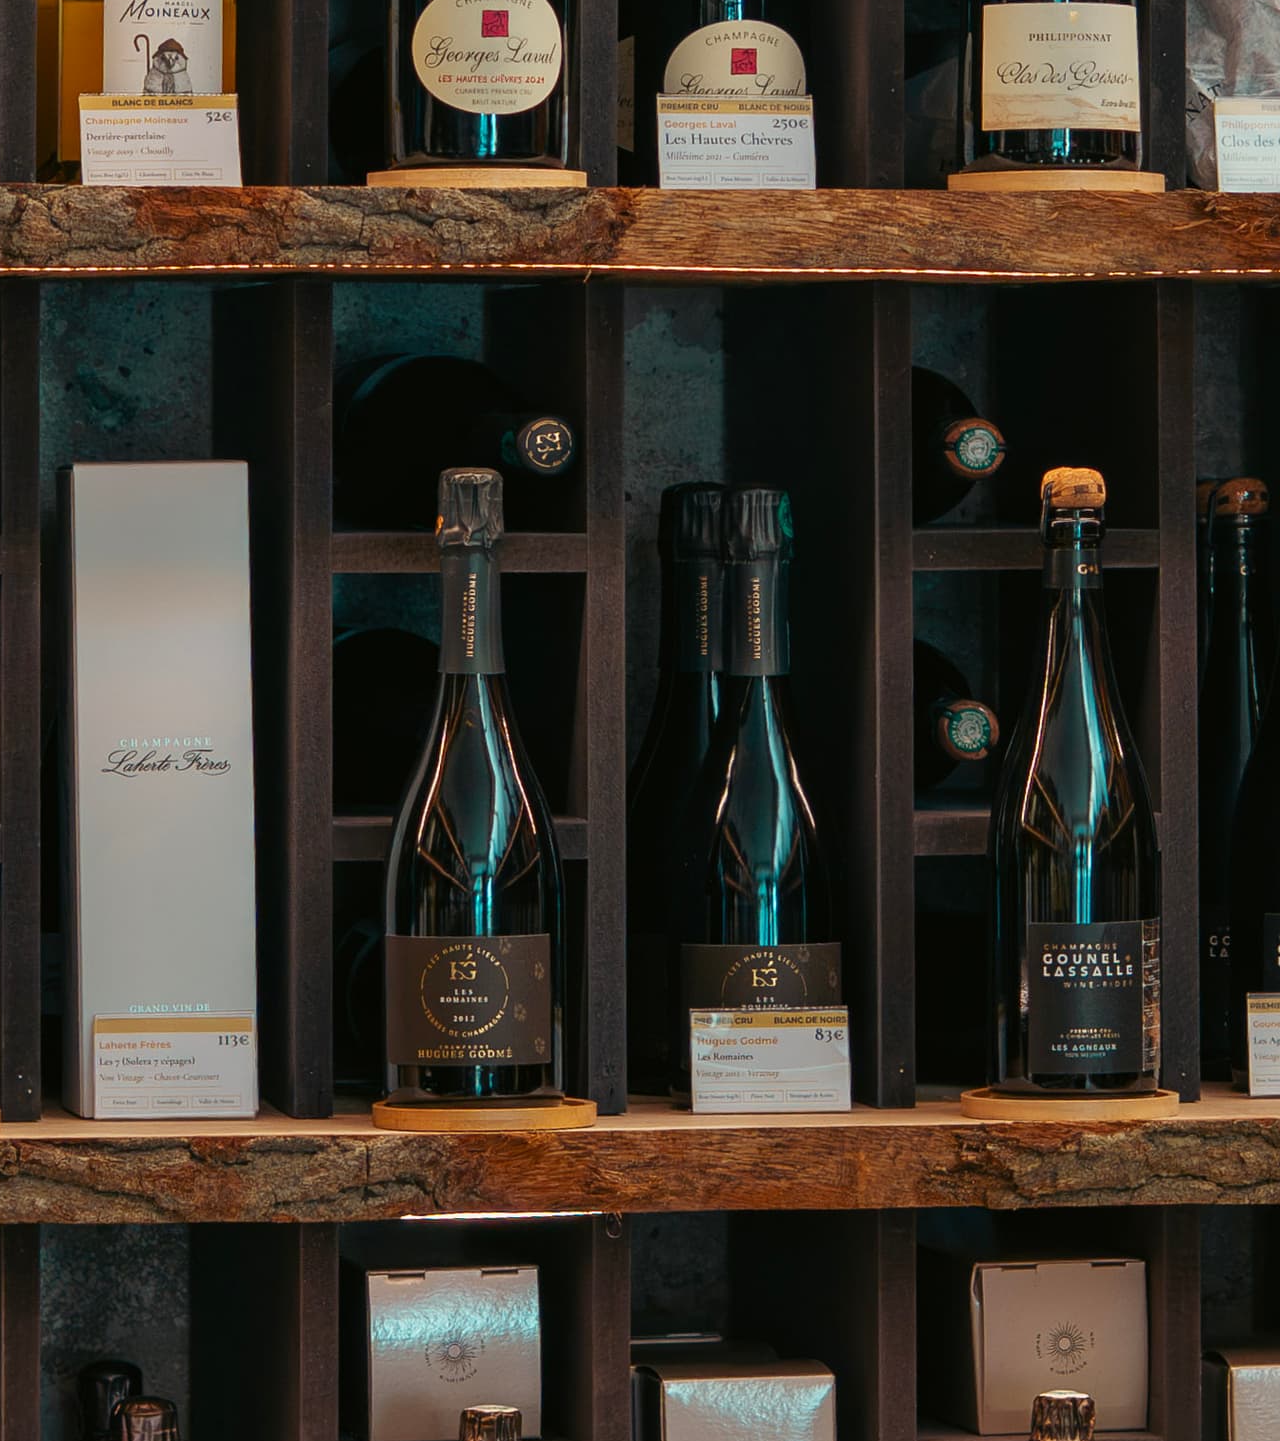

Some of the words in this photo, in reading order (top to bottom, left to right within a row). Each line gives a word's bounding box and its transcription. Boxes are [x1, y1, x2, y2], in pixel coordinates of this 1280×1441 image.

[705, 32, 780, 47] CHAMPAGNE
[1029, 33, 1111, 42] PHILIPPONNAT
[425, 36, 500, 73] Georges
[504, 36, 556, 64] Laval
[438, 75, 452, 83] LES
[456, 75, 487, 83] HAUTES
[997, 62, 1038, 84] Clos
[1042, 63, 1067, 83] des
[206, 112, 232, 123] 52€
[773, 119, 808, 131] 250€
[665, 133, 686, 145] Les
[691, 133, 736, 145] Hautes
[1221, 135, 1250, 147] Clos
[1254, 135, 1273, 147] des
[120, 737, 212, 747] CHAMPAGNE
[1043, 954, 1120, 964] GOUNEL
[1044, 965, 1133, 976] LASSALLE
[218, 1035, 249, 1047] 113€
[815, 1029, 844, 1043] 83€
[418, 1050, 465, 1058] HUGUES
